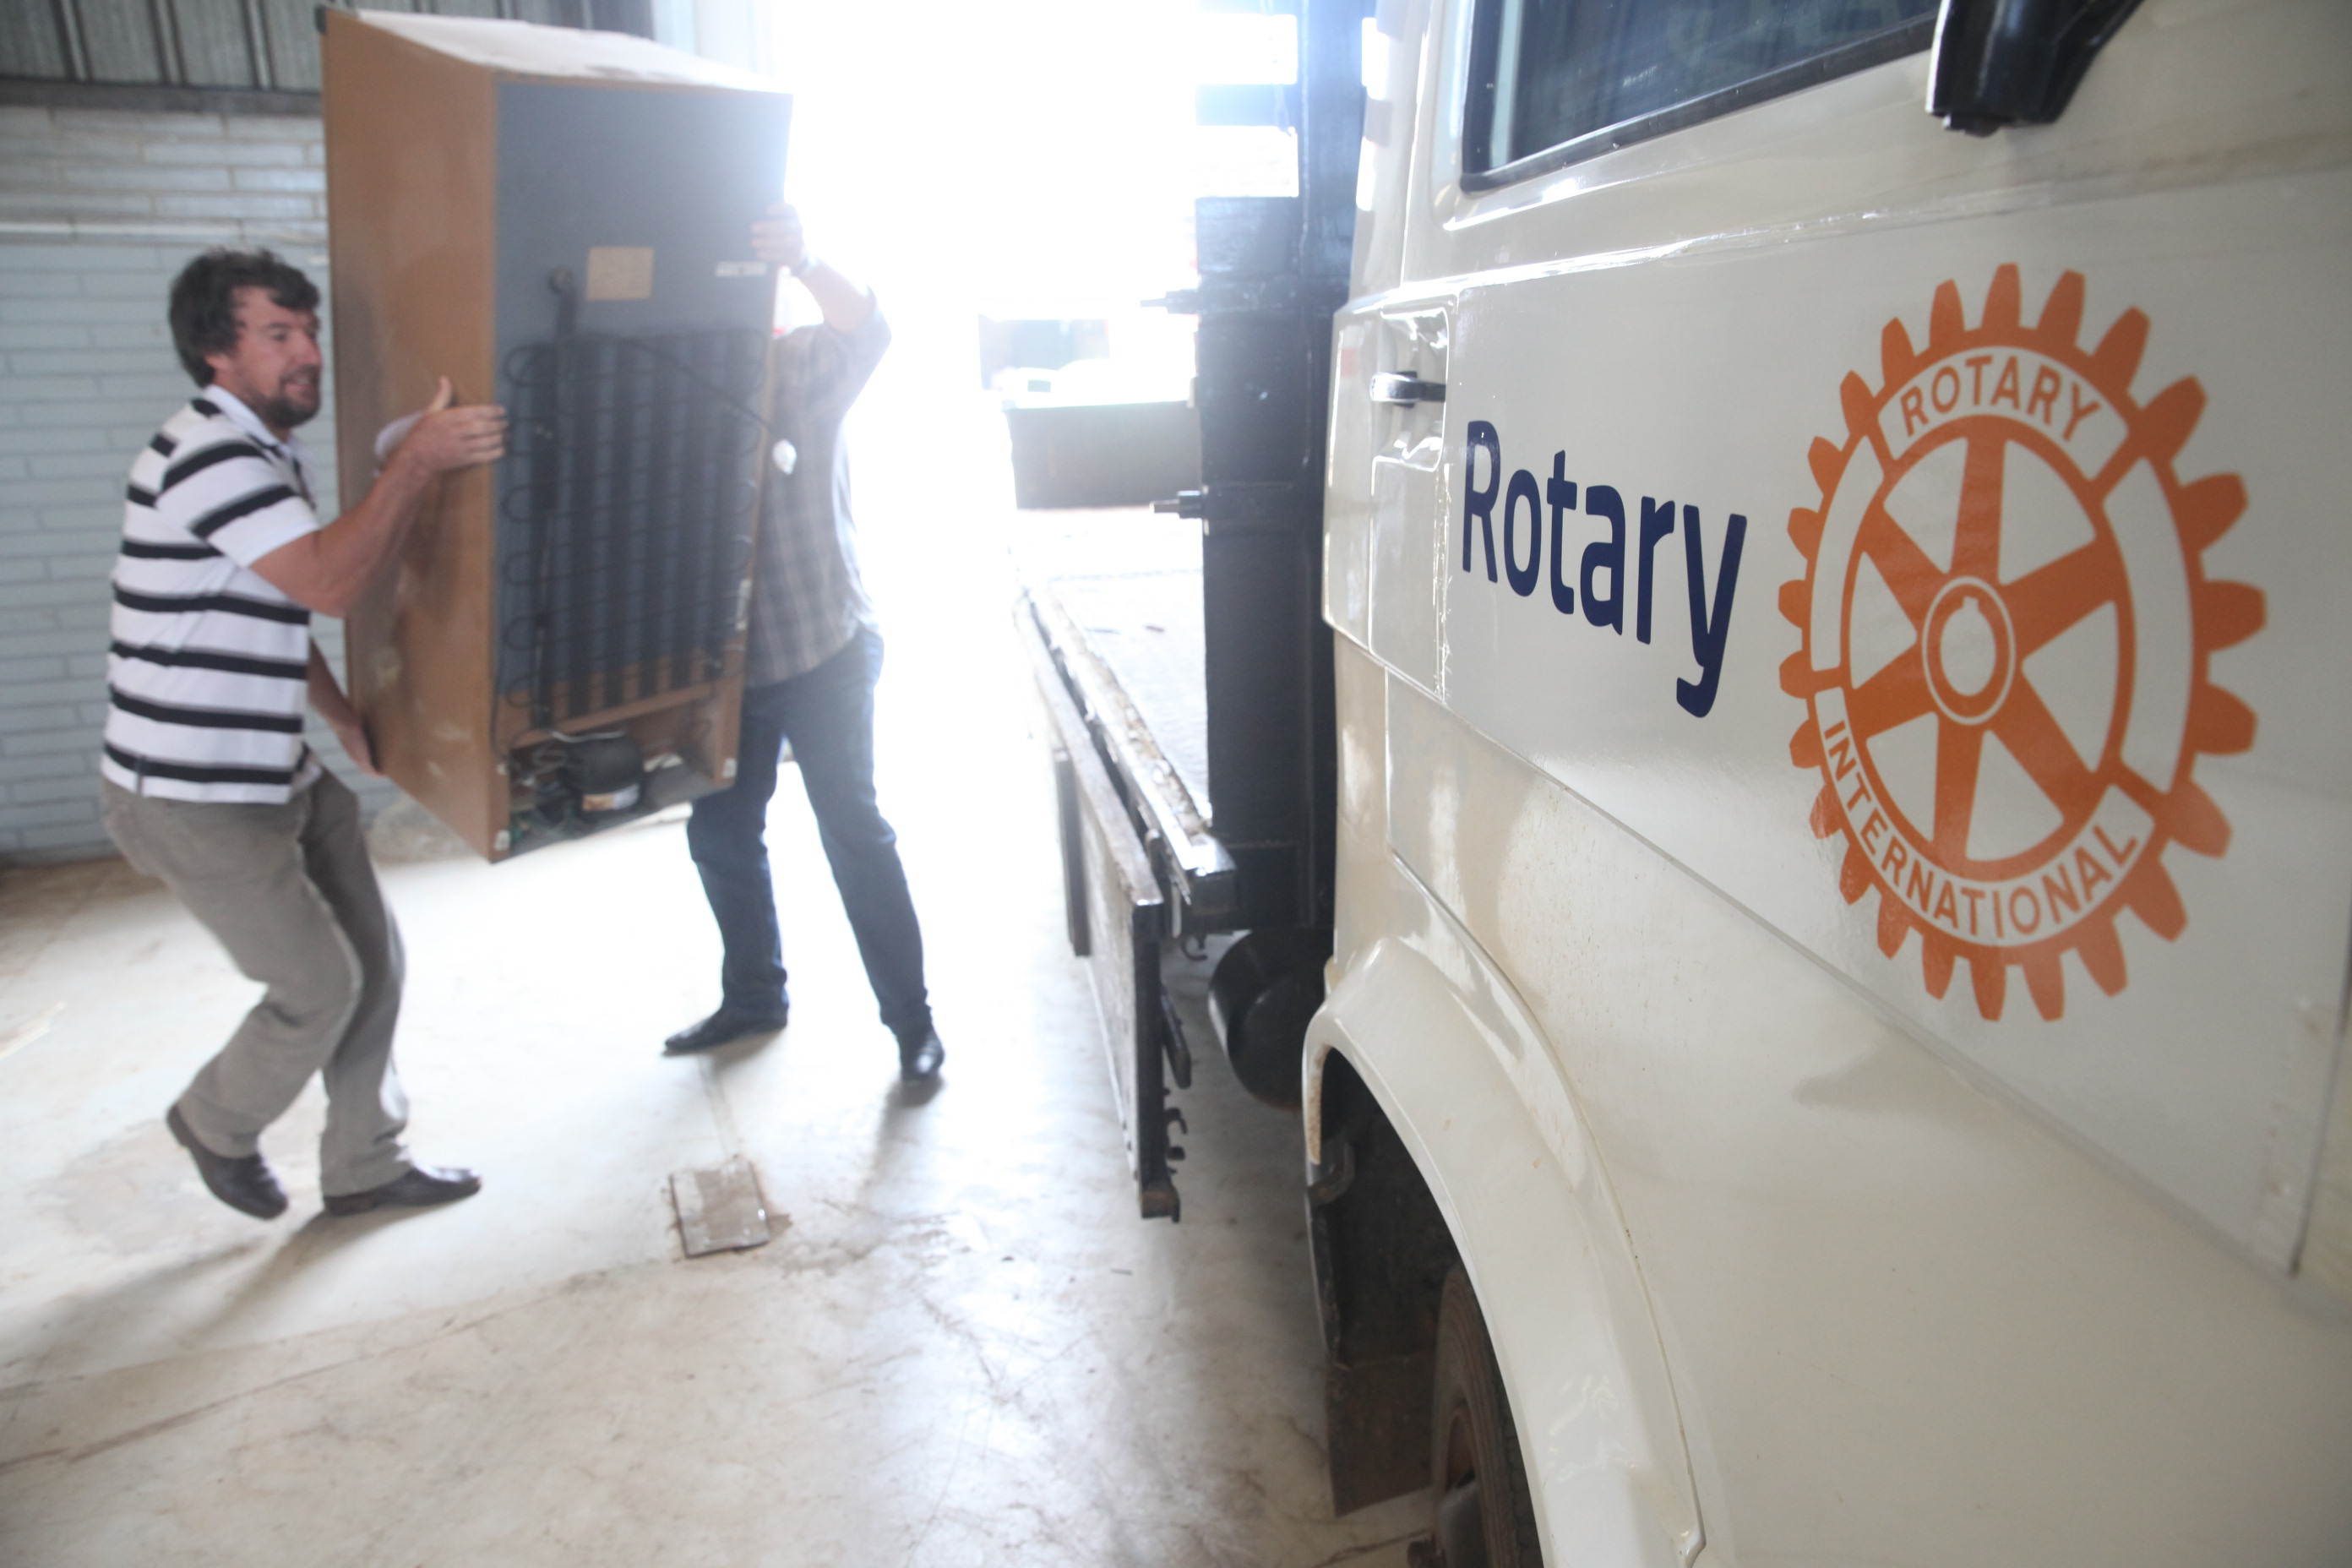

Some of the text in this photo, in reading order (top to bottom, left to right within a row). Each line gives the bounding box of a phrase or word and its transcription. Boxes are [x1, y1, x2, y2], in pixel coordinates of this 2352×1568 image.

[1901, 356, 2100, 440] ROTARY
[1462, 420, 1747, 718] Rotary
[1824, 721, 2137, 939] INTERNATIONAL
